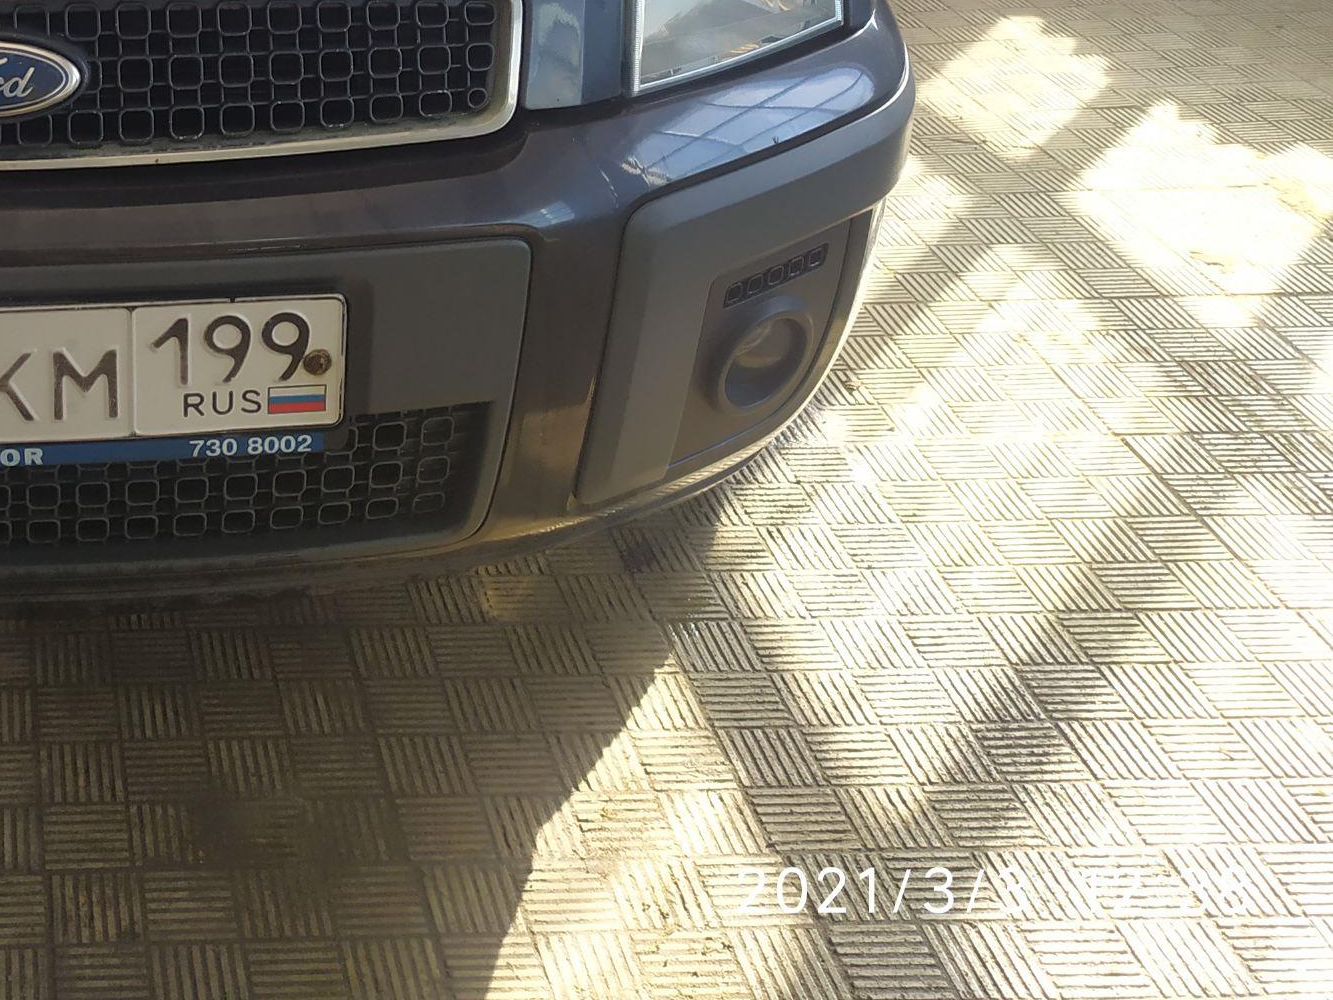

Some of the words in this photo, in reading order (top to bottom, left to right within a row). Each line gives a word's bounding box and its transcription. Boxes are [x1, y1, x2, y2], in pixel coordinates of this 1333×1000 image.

[151, 312, 311, 385] 199
[182, 389, 262, 418] RUS
[189, 438, 238, 457] 730
[247, 434, 313, 453] 8002
